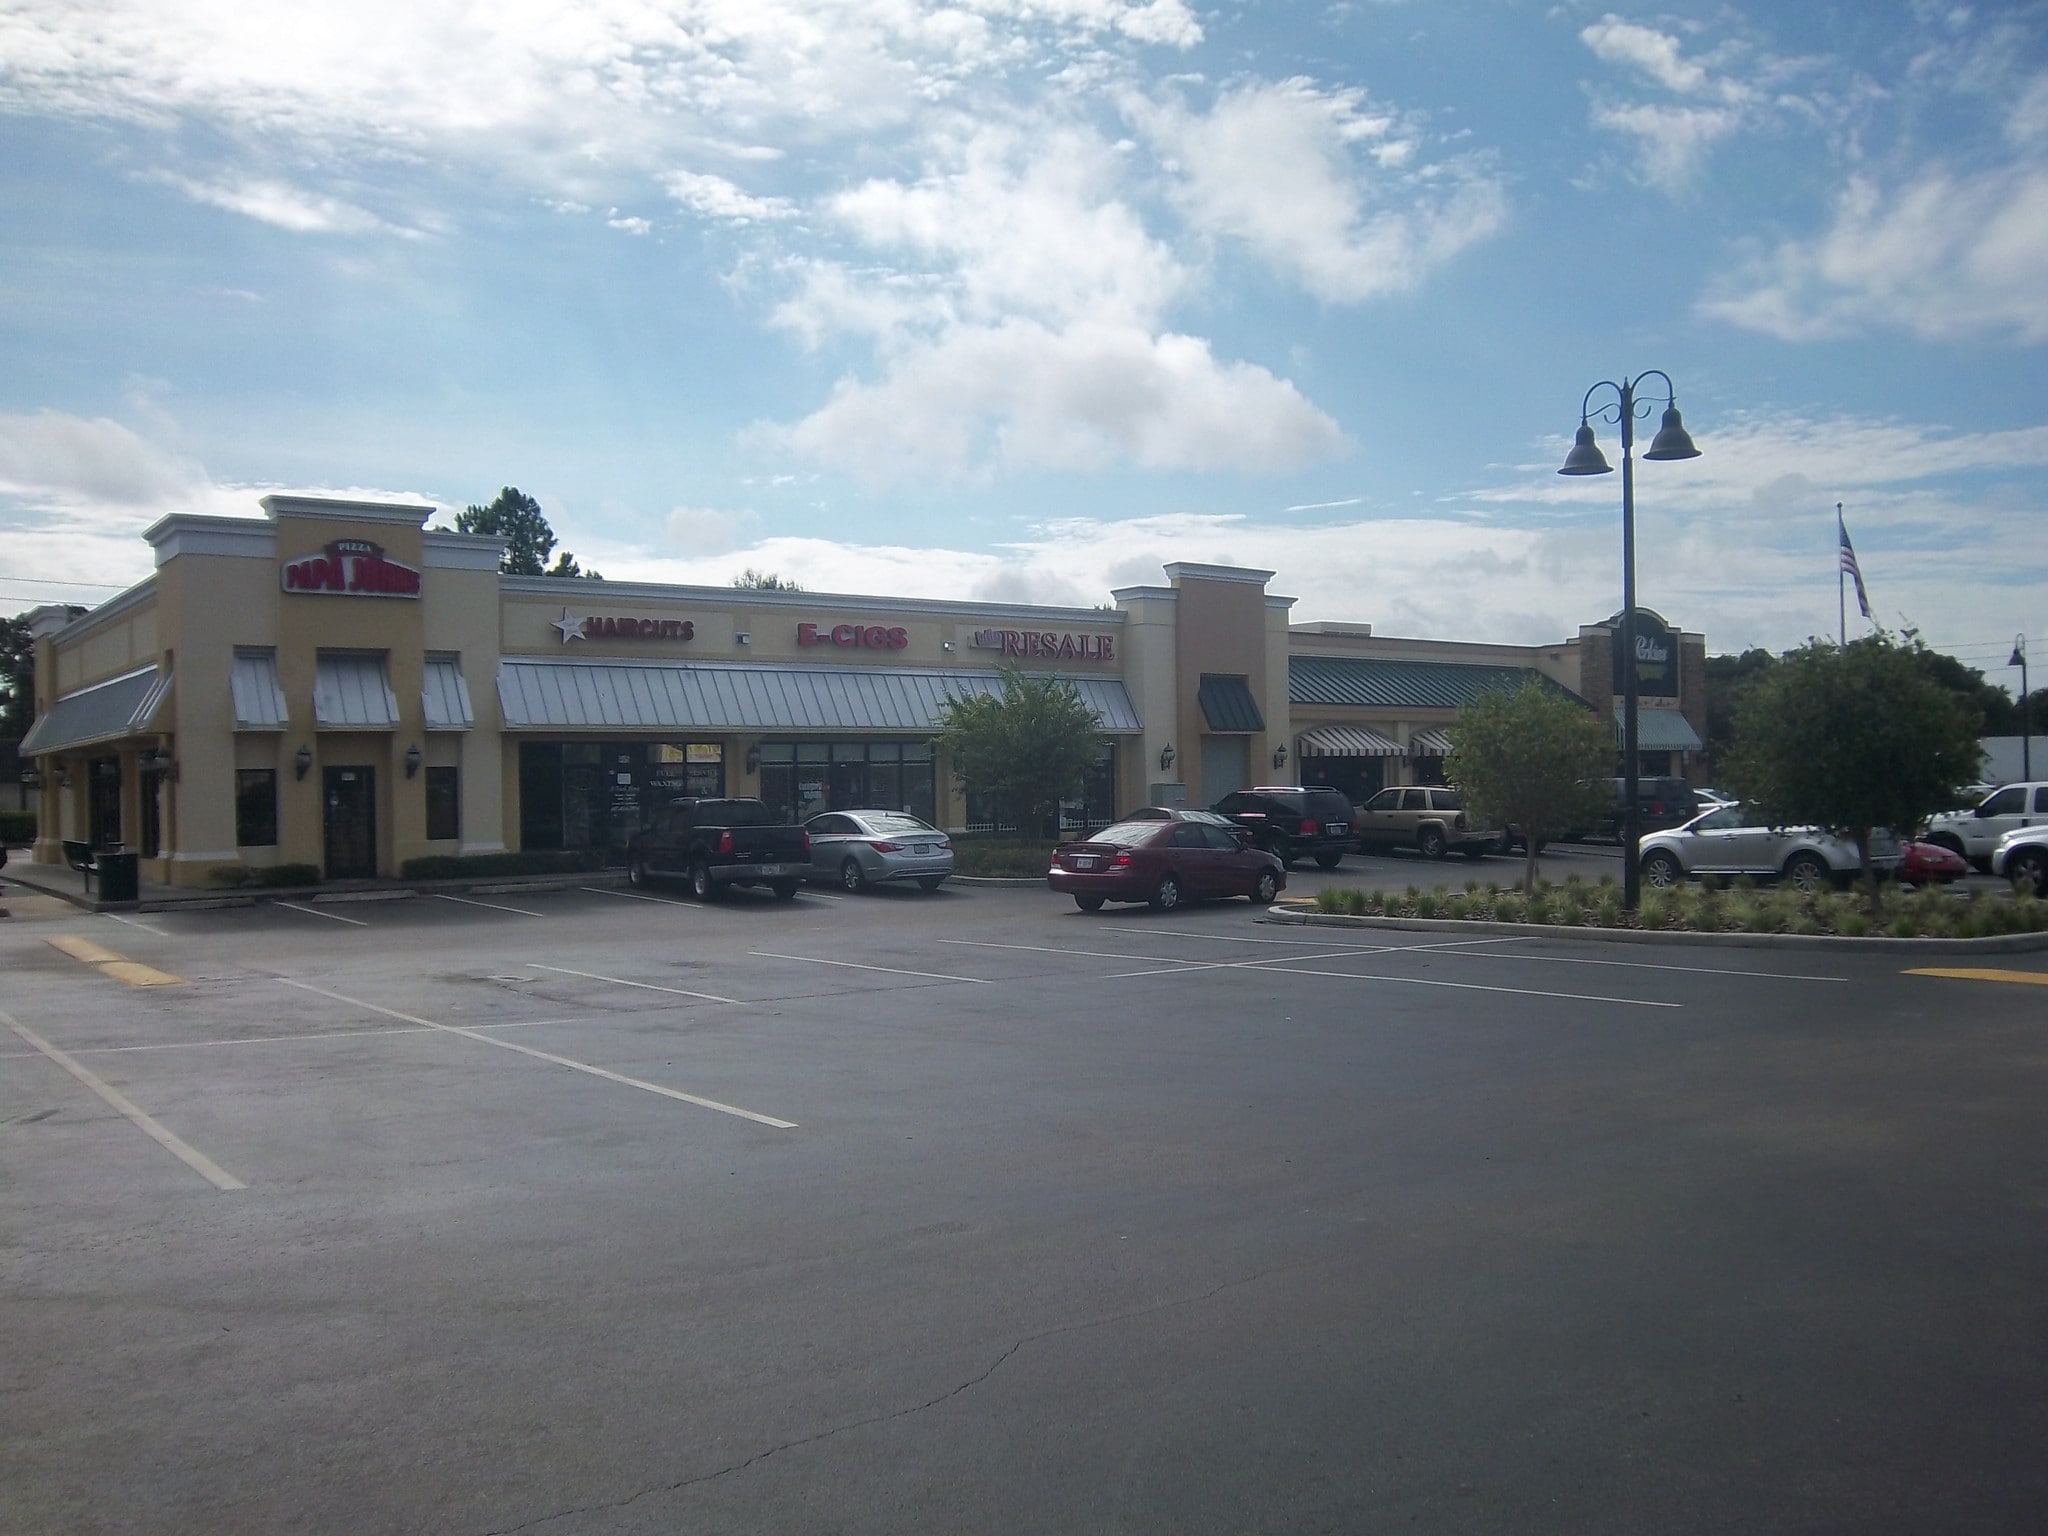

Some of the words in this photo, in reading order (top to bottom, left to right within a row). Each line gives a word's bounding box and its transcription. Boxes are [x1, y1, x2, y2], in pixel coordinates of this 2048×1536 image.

[338, 542, 371, 552] PIZZA
[286, 557, 346, 591] PAPA
[586, 616, 695, 642] HAIRCUTS
[797, 622, 908, 650] E-CIGS
[1001, 630, 1115, 661] RESALE
